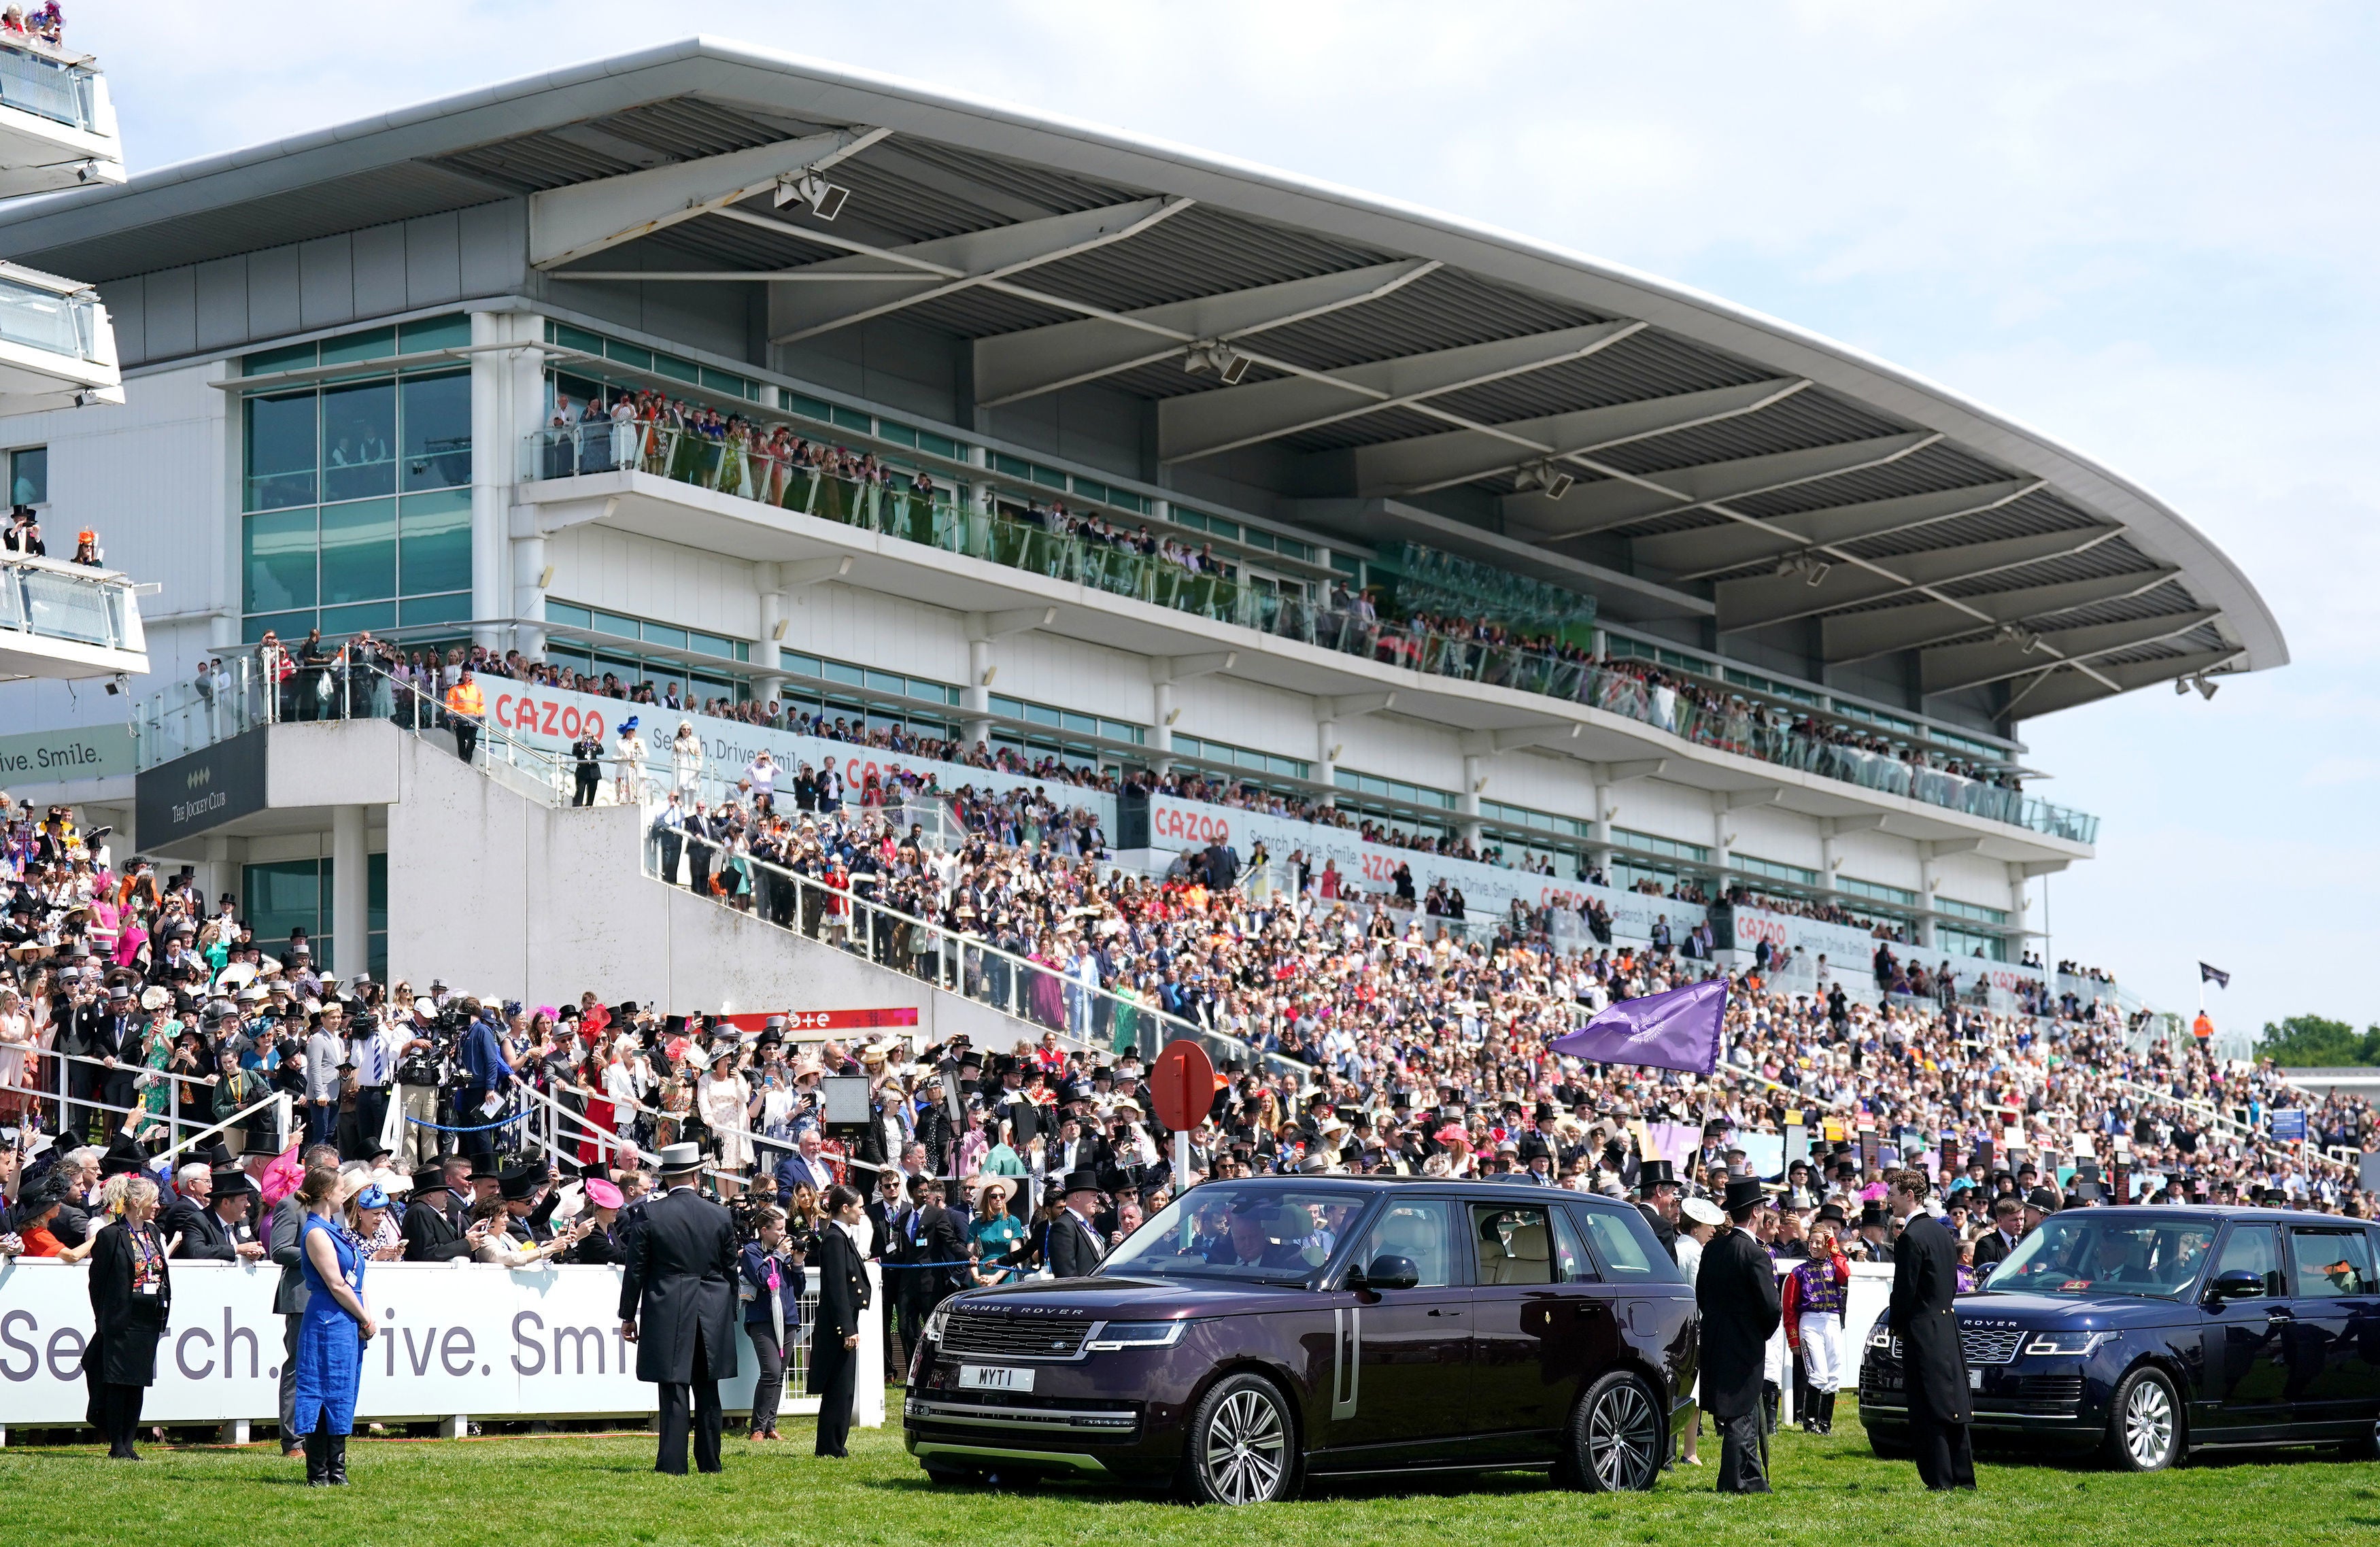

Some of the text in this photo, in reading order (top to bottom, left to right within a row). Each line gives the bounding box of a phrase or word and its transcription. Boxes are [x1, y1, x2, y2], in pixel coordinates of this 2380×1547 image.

[496, 694, 605, 743] CAZOO
[37, 743, 102, 768] Smile.
[653, 728, 712, 758] Seh.
[716, 738, 755, 764] Drive
[172, 792, 226, 823] THE JOCKEY CLUB
[1155, 807, 1229, 843] CAZOO
[1738, 916, 1786, 946] CAZOO
[961, 1304, 1084, 1315] RANGE ROVER
[0, 1306, 279, 1382] Sech.
[380, 1307, 490, 1376] ive.
